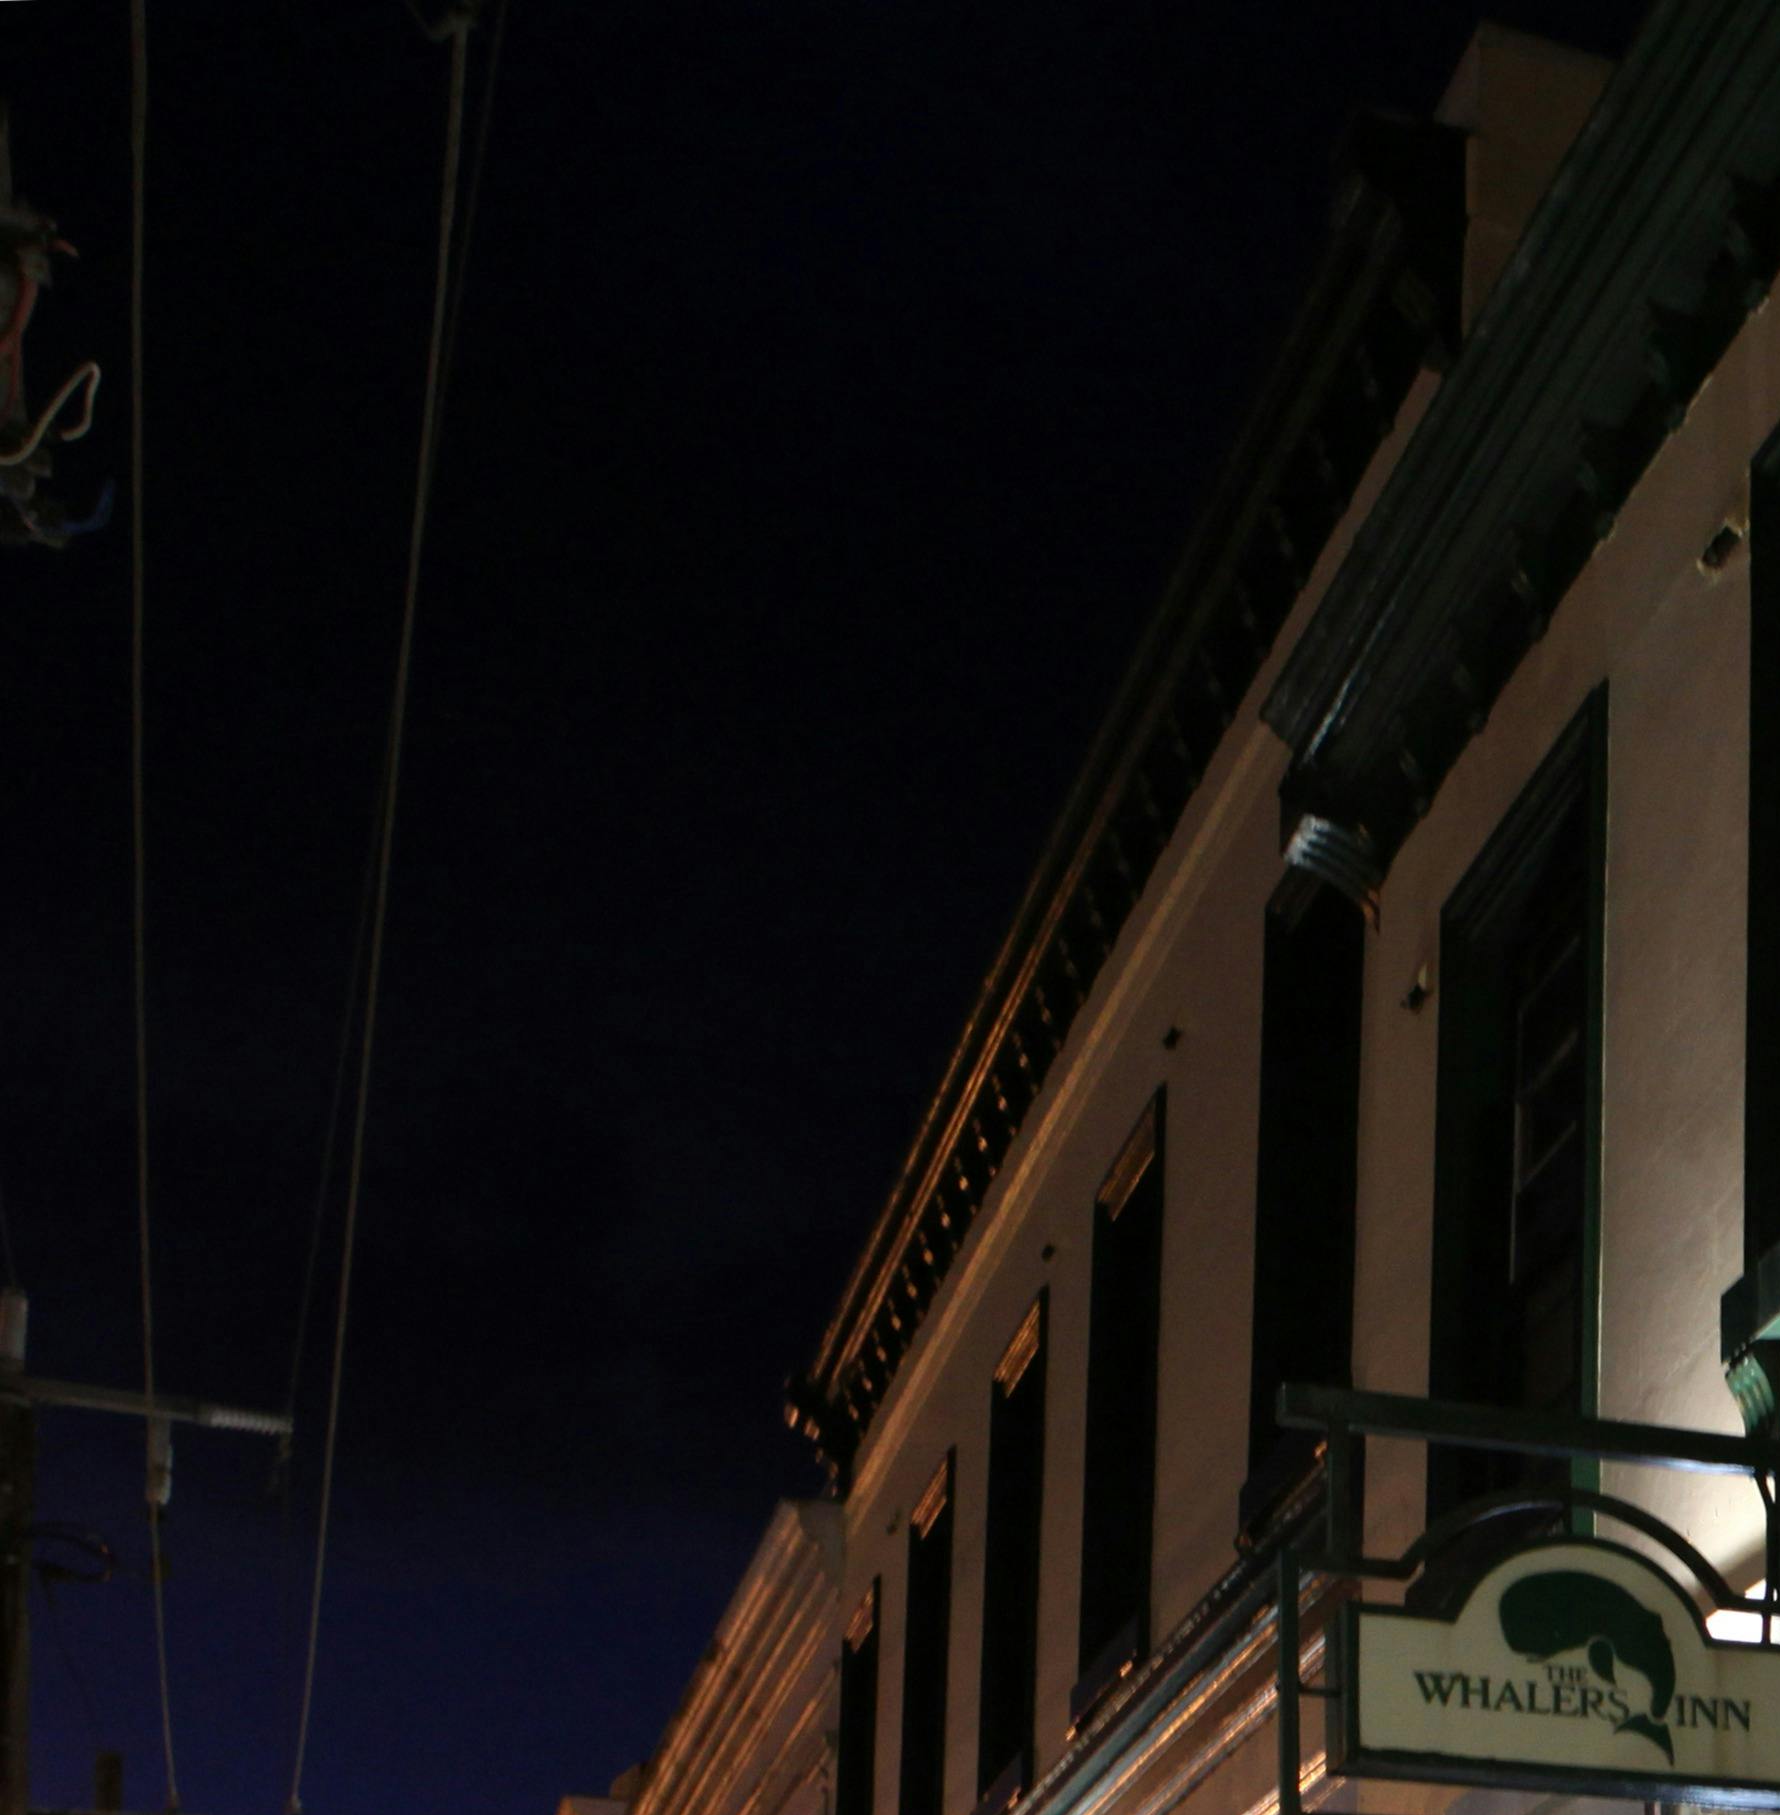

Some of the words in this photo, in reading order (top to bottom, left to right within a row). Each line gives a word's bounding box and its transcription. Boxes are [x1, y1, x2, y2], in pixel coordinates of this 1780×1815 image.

[1546, 1663, 1588, 1685] THE
[1413, 1670, 1631, 1724] WHALERS
[1676, 1699, 1752, 1732] INN
